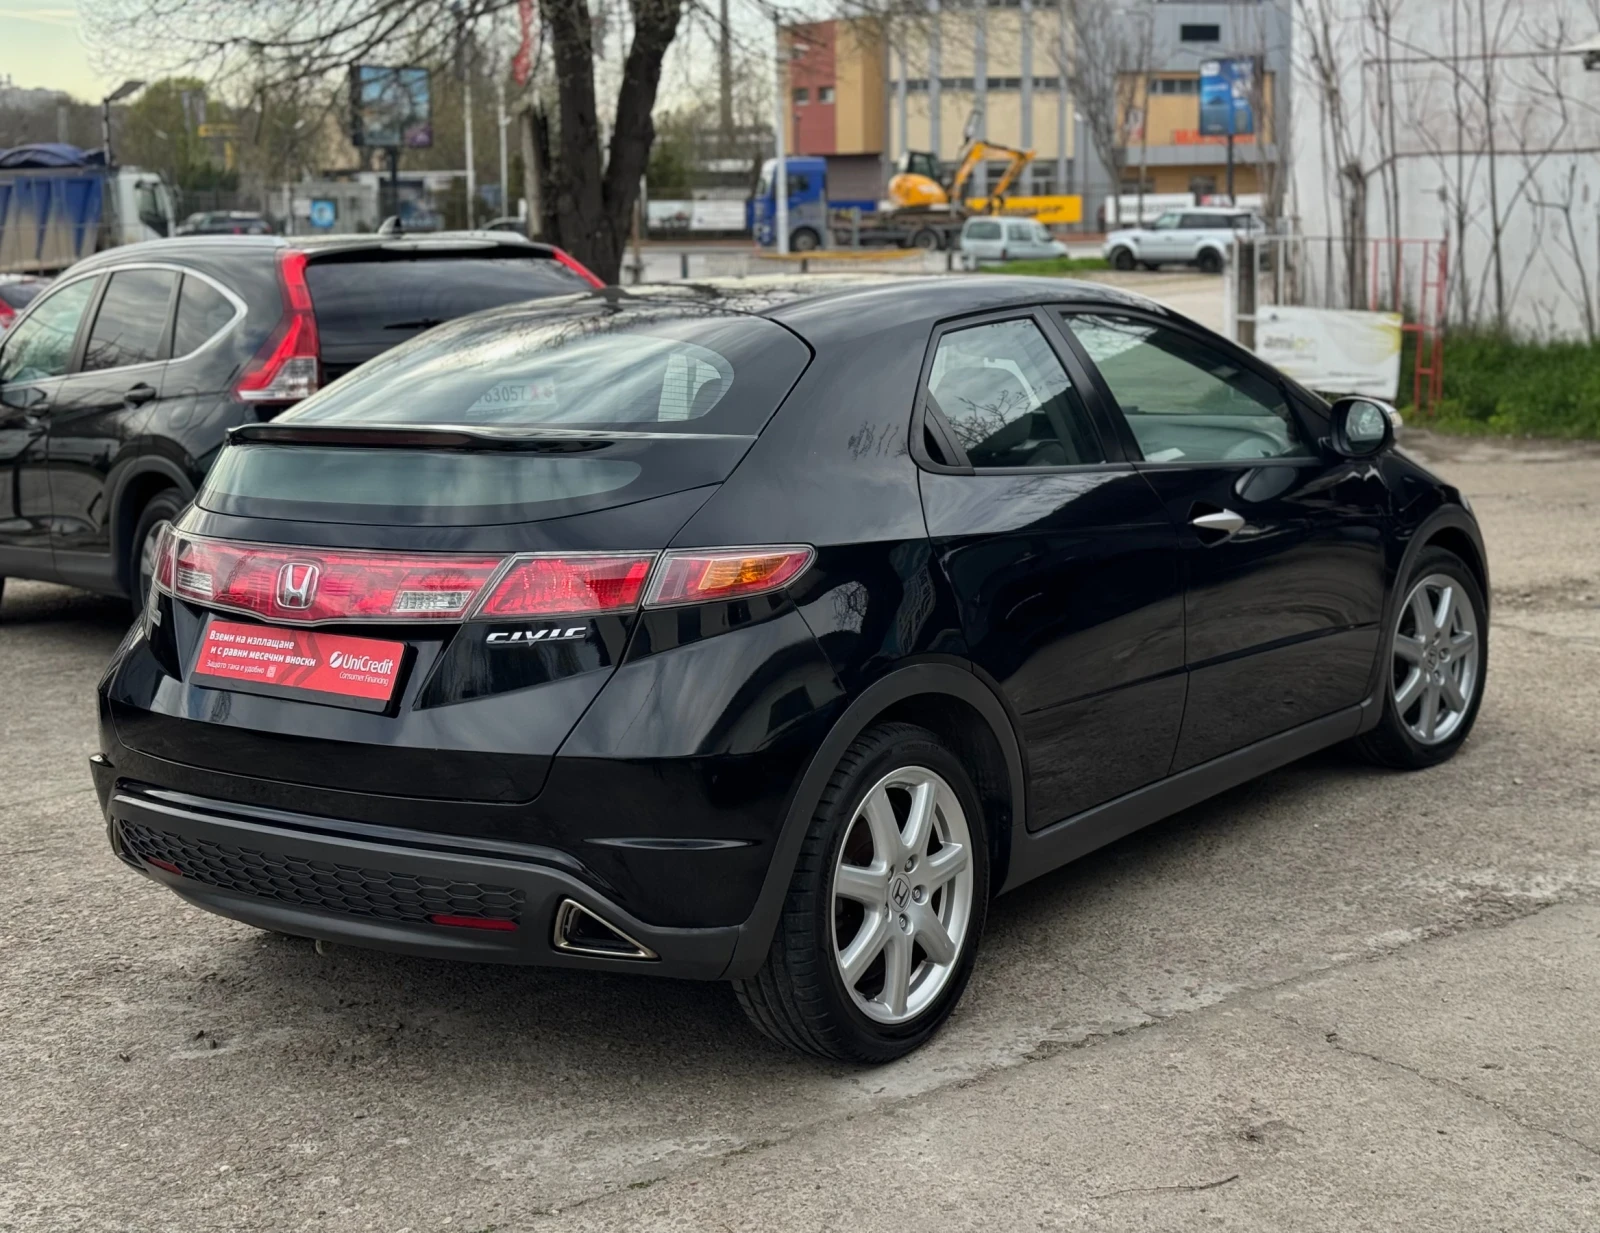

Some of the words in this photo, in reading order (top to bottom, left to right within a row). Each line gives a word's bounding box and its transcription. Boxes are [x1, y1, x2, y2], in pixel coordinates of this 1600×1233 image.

[209, 630, 234, 643] Вземи
[235, 635, 246, 643] на
[247, 636, 295, 650] изплащане
[486, 627, 586, 647] CIVIC
[206, 659, 227, 669] Защото
[227, 663, 240, 671] така
[210, 646, 217, 654] и
[217, 647, 223, 655] с
[222, 648, 248, 658] равни
[248, 651, 285, 663] месечни
[285, 655, 317, 667] вноски
[342, 653, 393, 675] UniCredit
[339, 671, 365, 682] Consumer
[364, 674, 389, 687] Financing
